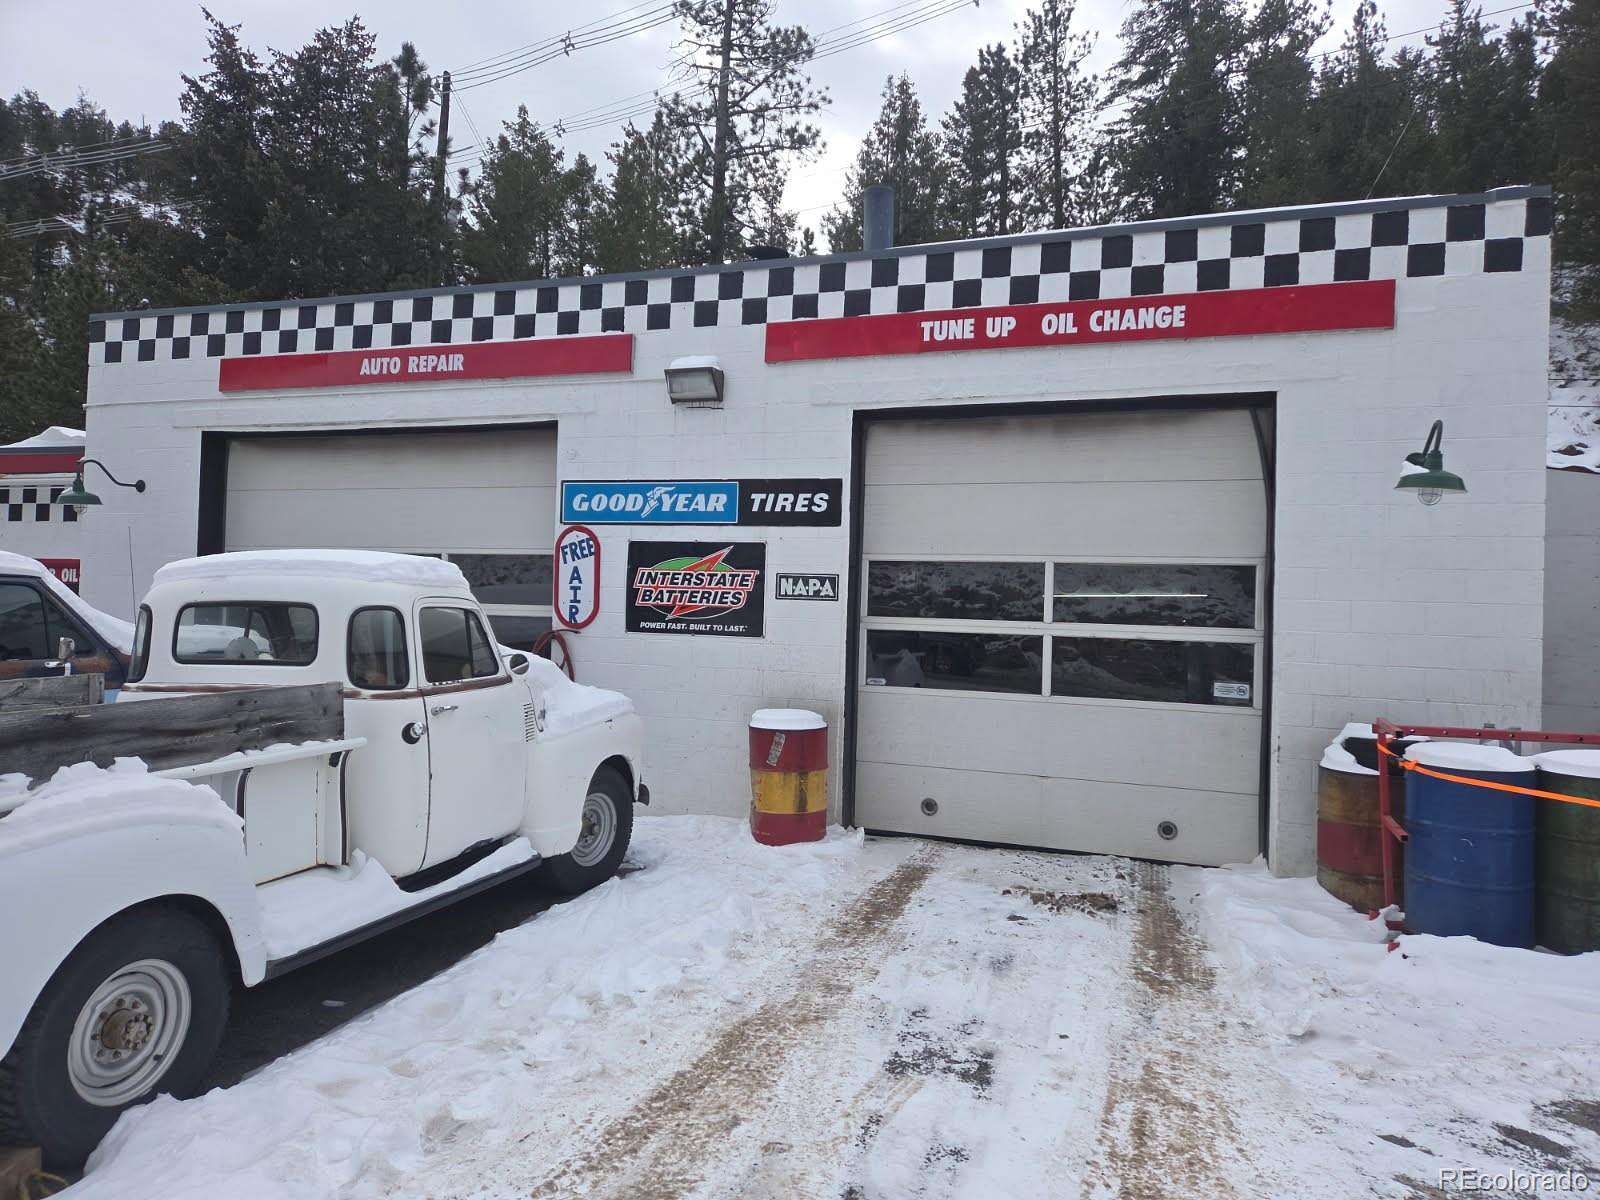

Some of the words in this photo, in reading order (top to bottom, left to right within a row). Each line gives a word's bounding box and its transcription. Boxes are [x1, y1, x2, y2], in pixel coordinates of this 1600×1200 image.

[920, 318, 975, 342] TUNE
[985, 316, 1017, 337] UP
[1041, 312, 1078, 335] OIL
[1089, 305, 1187, 333] CHANGE
[359, 356, 401, 376] AUTO
[407, 353, 464, 373] REPAIR
[572, 491, 729, 513] GOODYEAR
[750, 492, 830, 513] TIRES
[560, 537, 596, 565] FREE
[61, 567, 79, 583] OIL
[636, 570, 753, 589] INTERSTATE
[568, 565, 583, 625] AIR
[639, 589, 743, 606] BATTERIES
[639, 621, 666, 630] POWER
[667, 622, 688, 631] FAST.
[689, 623, 711, 631] BUILT
[713, 624, 723, 632] TO
